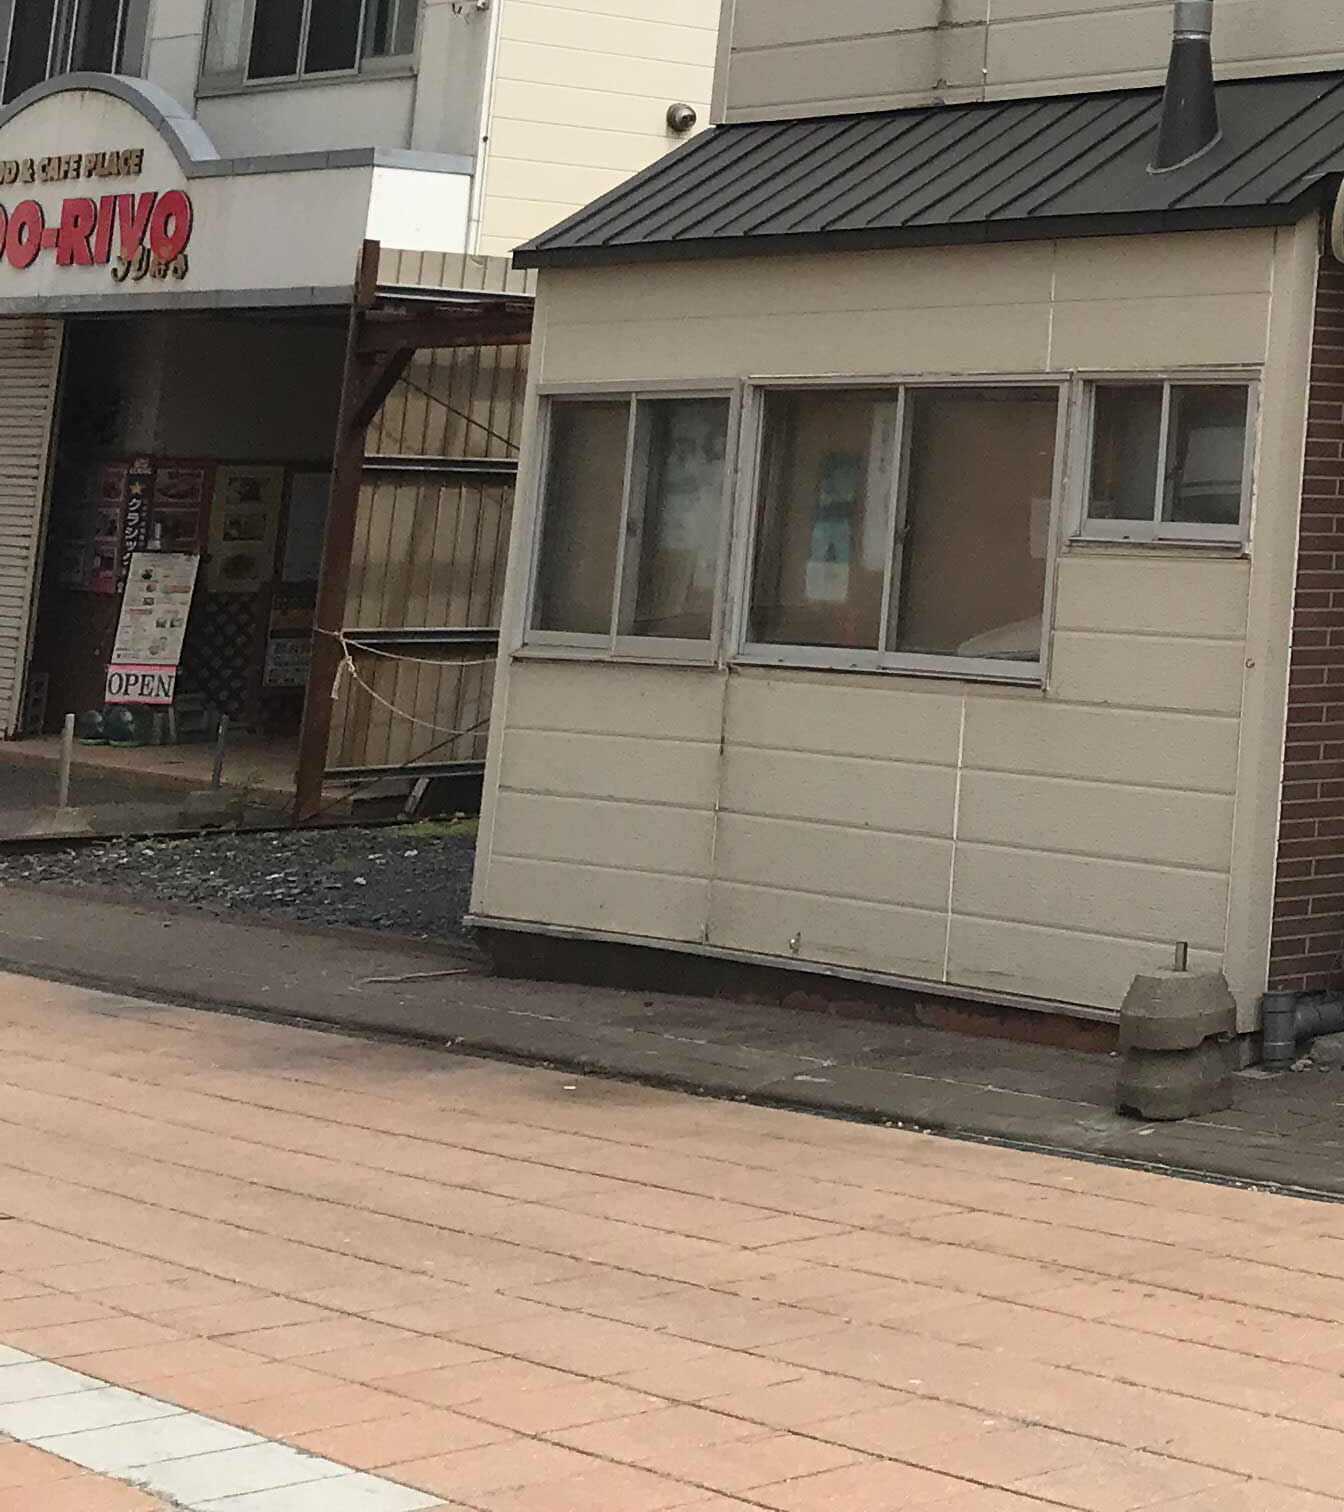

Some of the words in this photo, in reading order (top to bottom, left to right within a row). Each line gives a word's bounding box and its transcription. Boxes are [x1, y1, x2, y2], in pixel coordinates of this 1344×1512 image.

[37, 153, 83, 182] CAFE
[83, 148, 144, 178] PLACE
[0, 189, 194, 269] O-RIVO
[108, 672, 175, 698] OPEN
